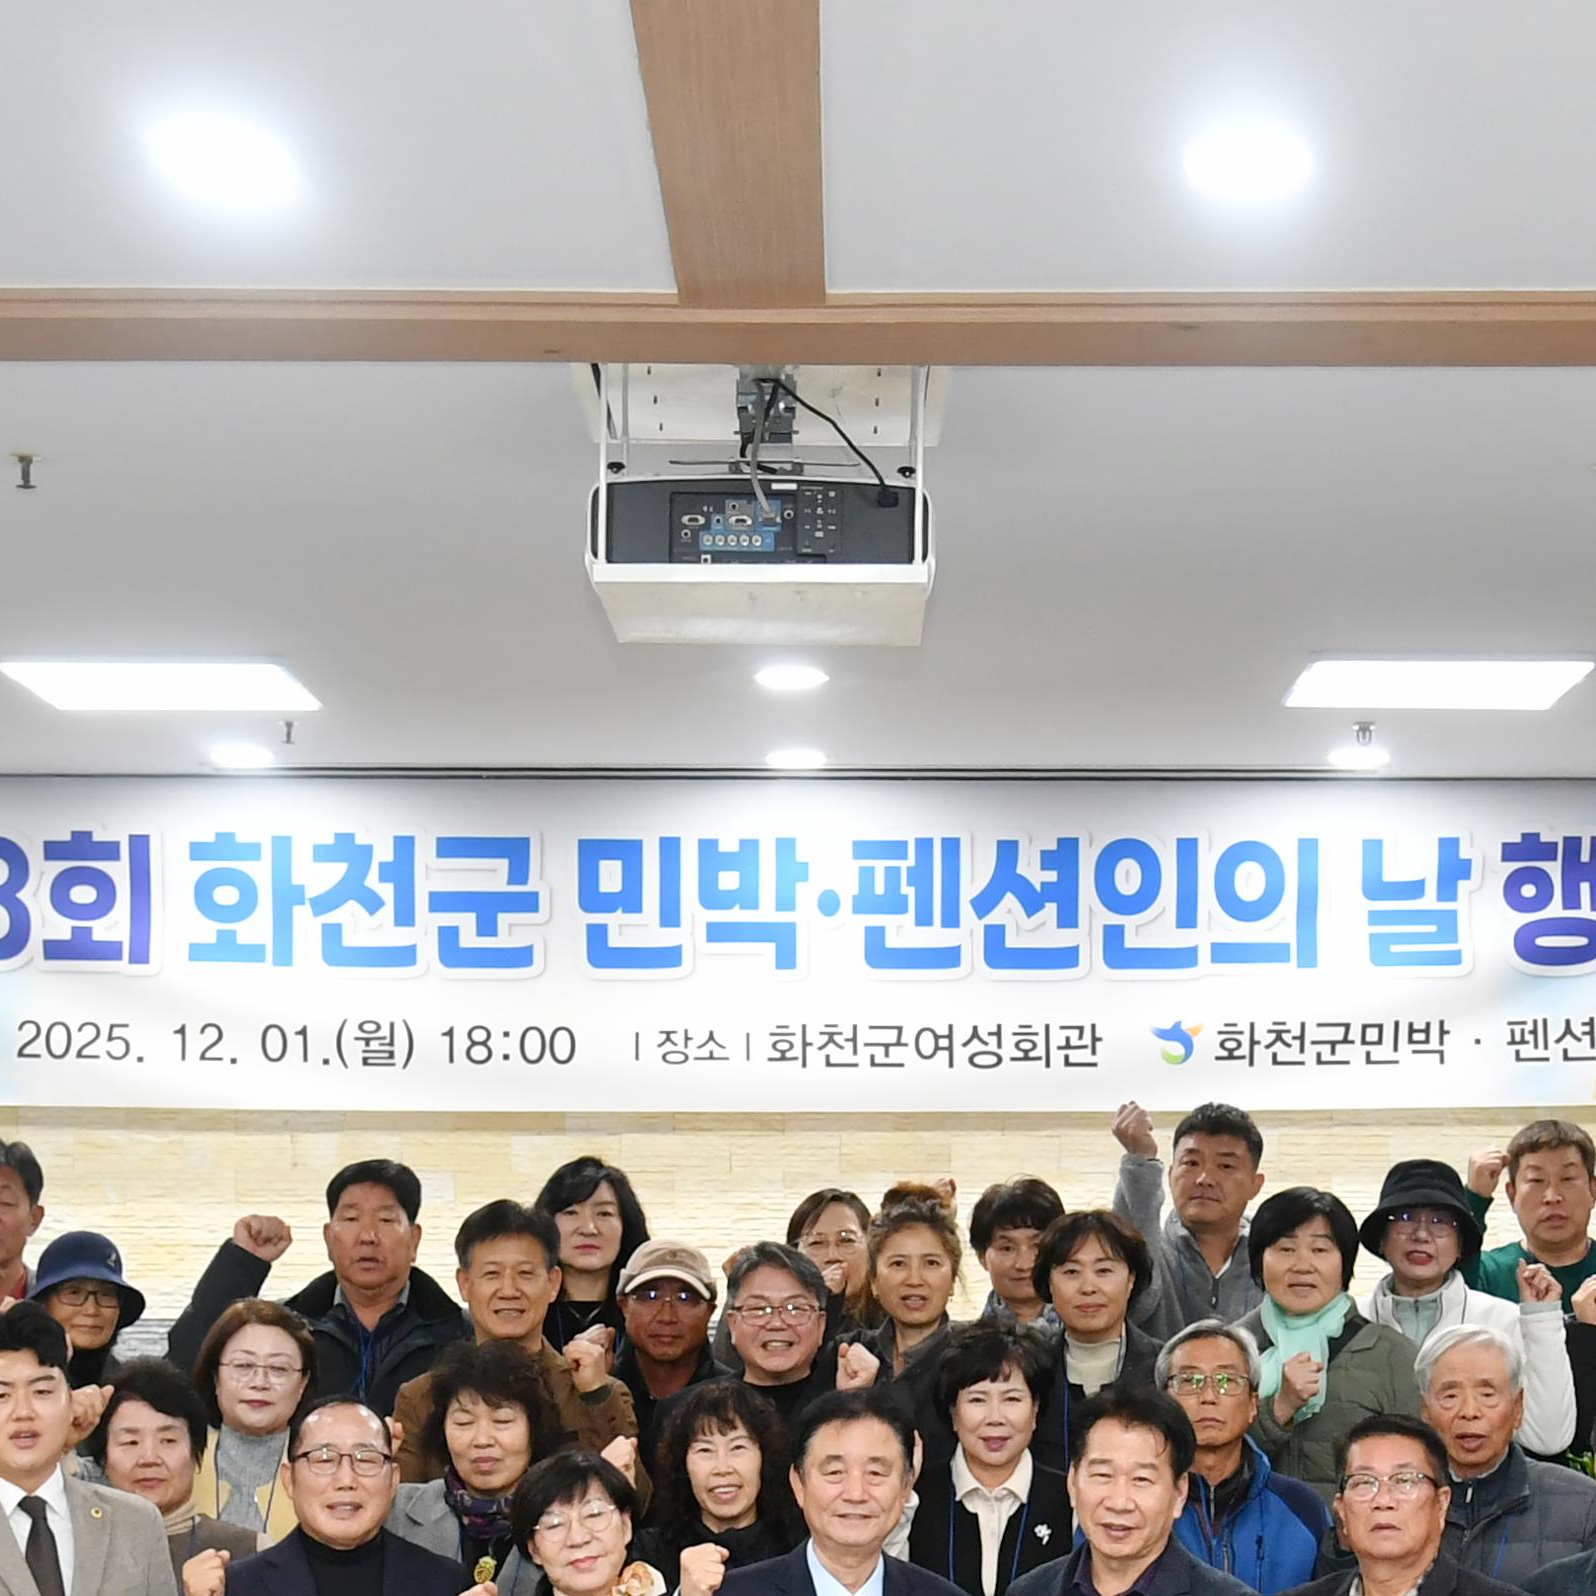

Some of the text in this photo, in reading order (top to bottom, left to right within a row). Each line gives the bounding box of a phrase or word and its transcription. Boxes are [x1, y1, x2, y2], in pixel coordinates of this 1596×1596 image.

[188, 832, 540, 969] 화천군
[577, 835, 1318, 970] 민박·펜션인의
[1362, 836, 1473, 966] 날
[16, 1019, 145, 1063] 2025.
[171, 1023, 239, 1065] 12.
[260, 1018, 416, 1070] 01.(월)
[440, 1024, 577, 1066] 18:00
[656, 1022, 1104, 1070] 장소 화천군여성회관
[1214, 1018, 1451, 1068] 화천군민박
